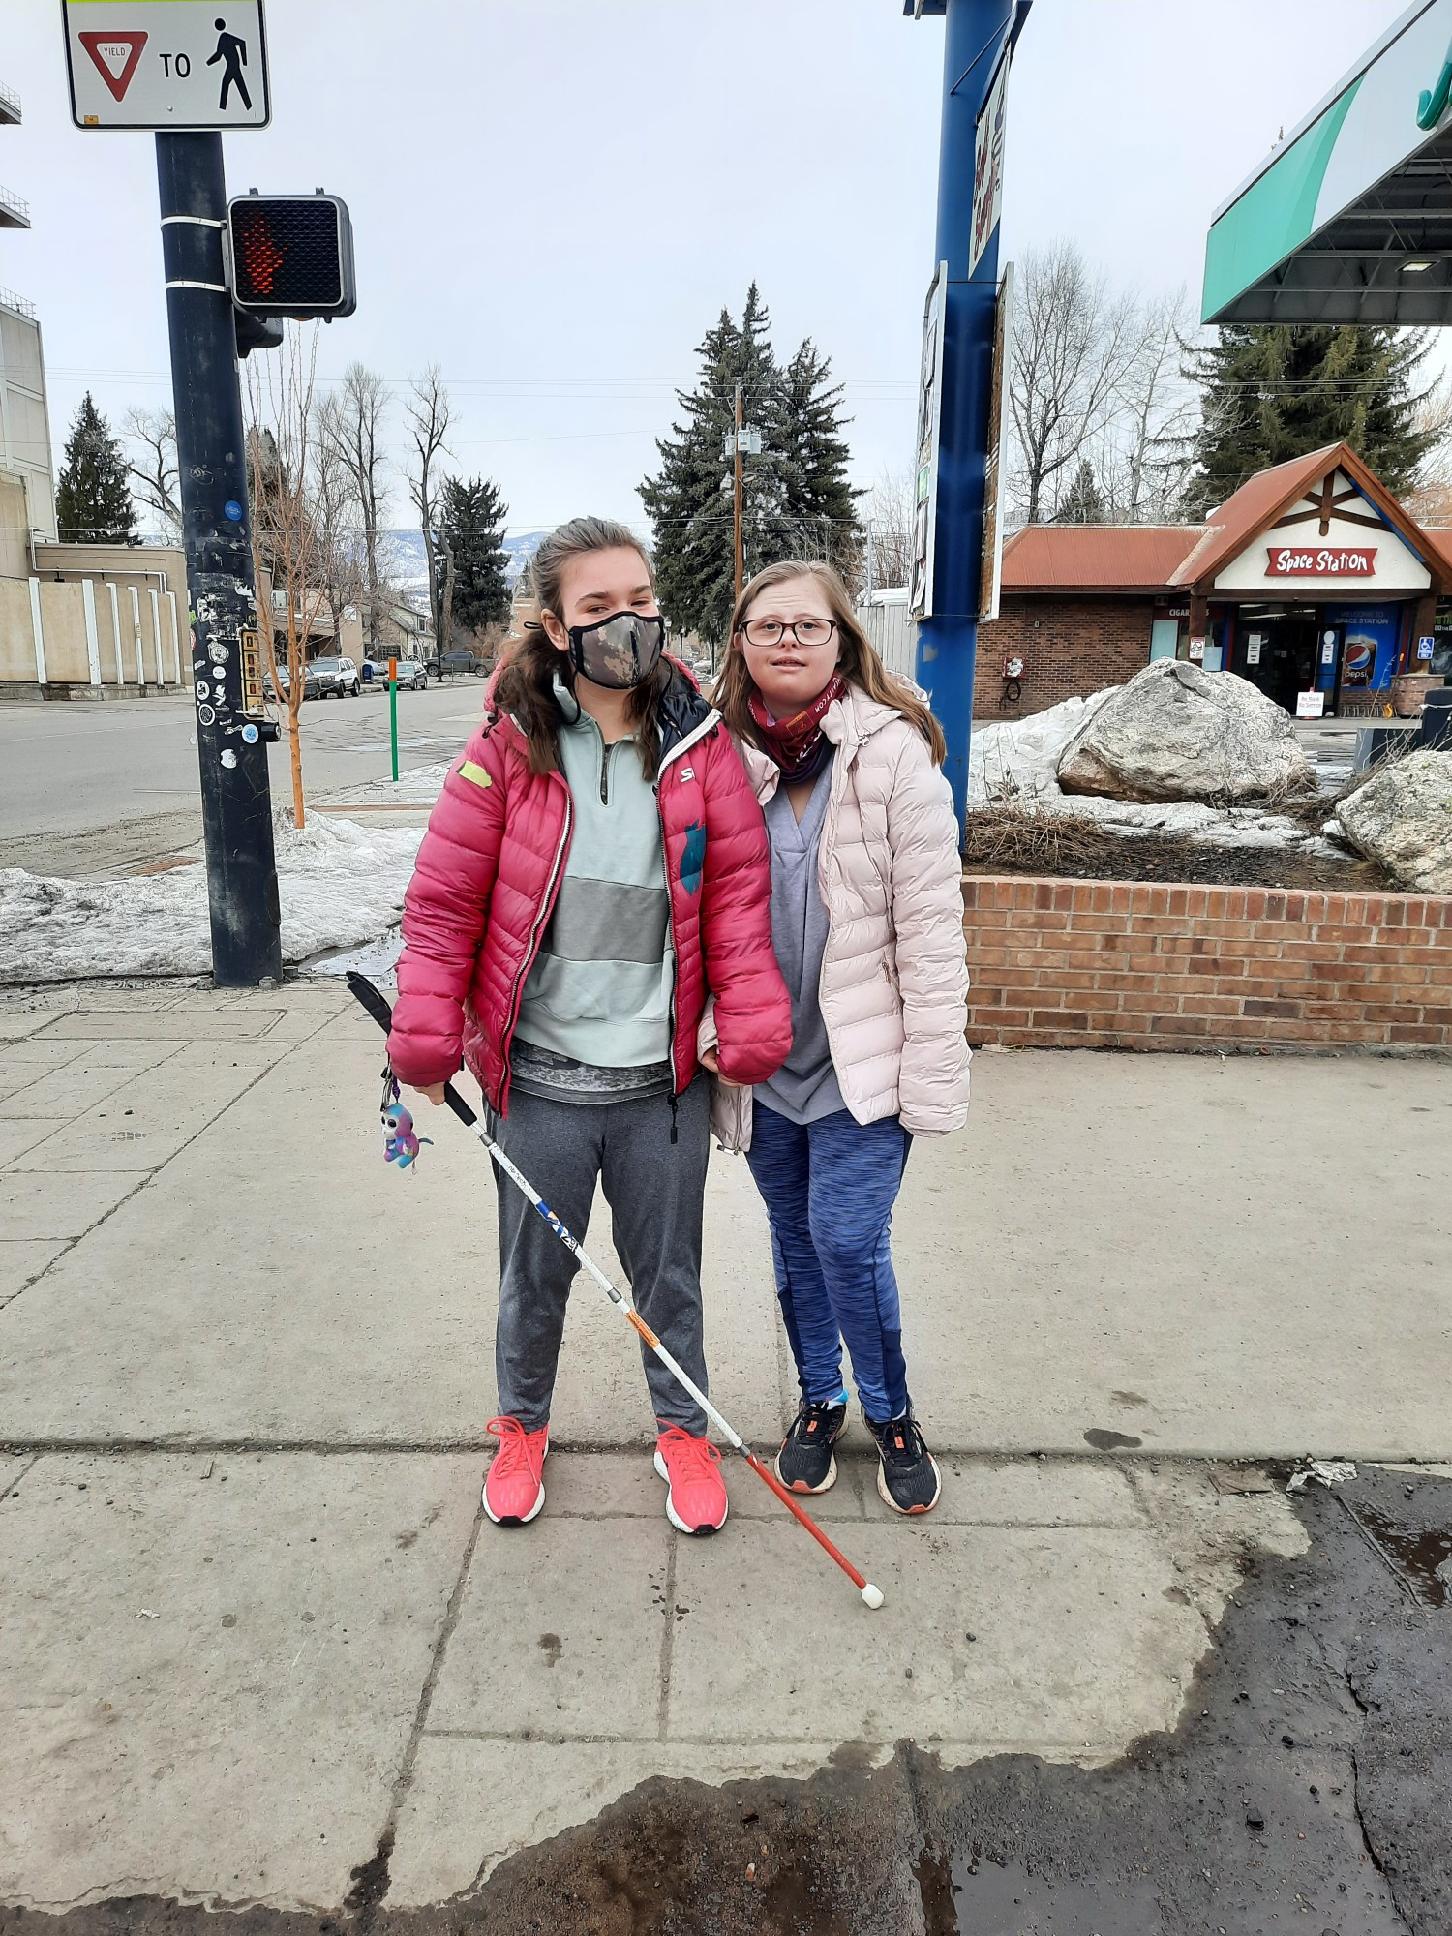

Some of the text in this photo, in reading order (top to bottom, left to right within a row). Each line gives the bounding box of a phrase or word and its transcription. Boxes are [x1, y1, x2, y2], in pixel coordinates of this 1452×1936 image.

[104, 47, 191, 78] YIELD TO
[1276, 549, 1368, 572] Space Station
